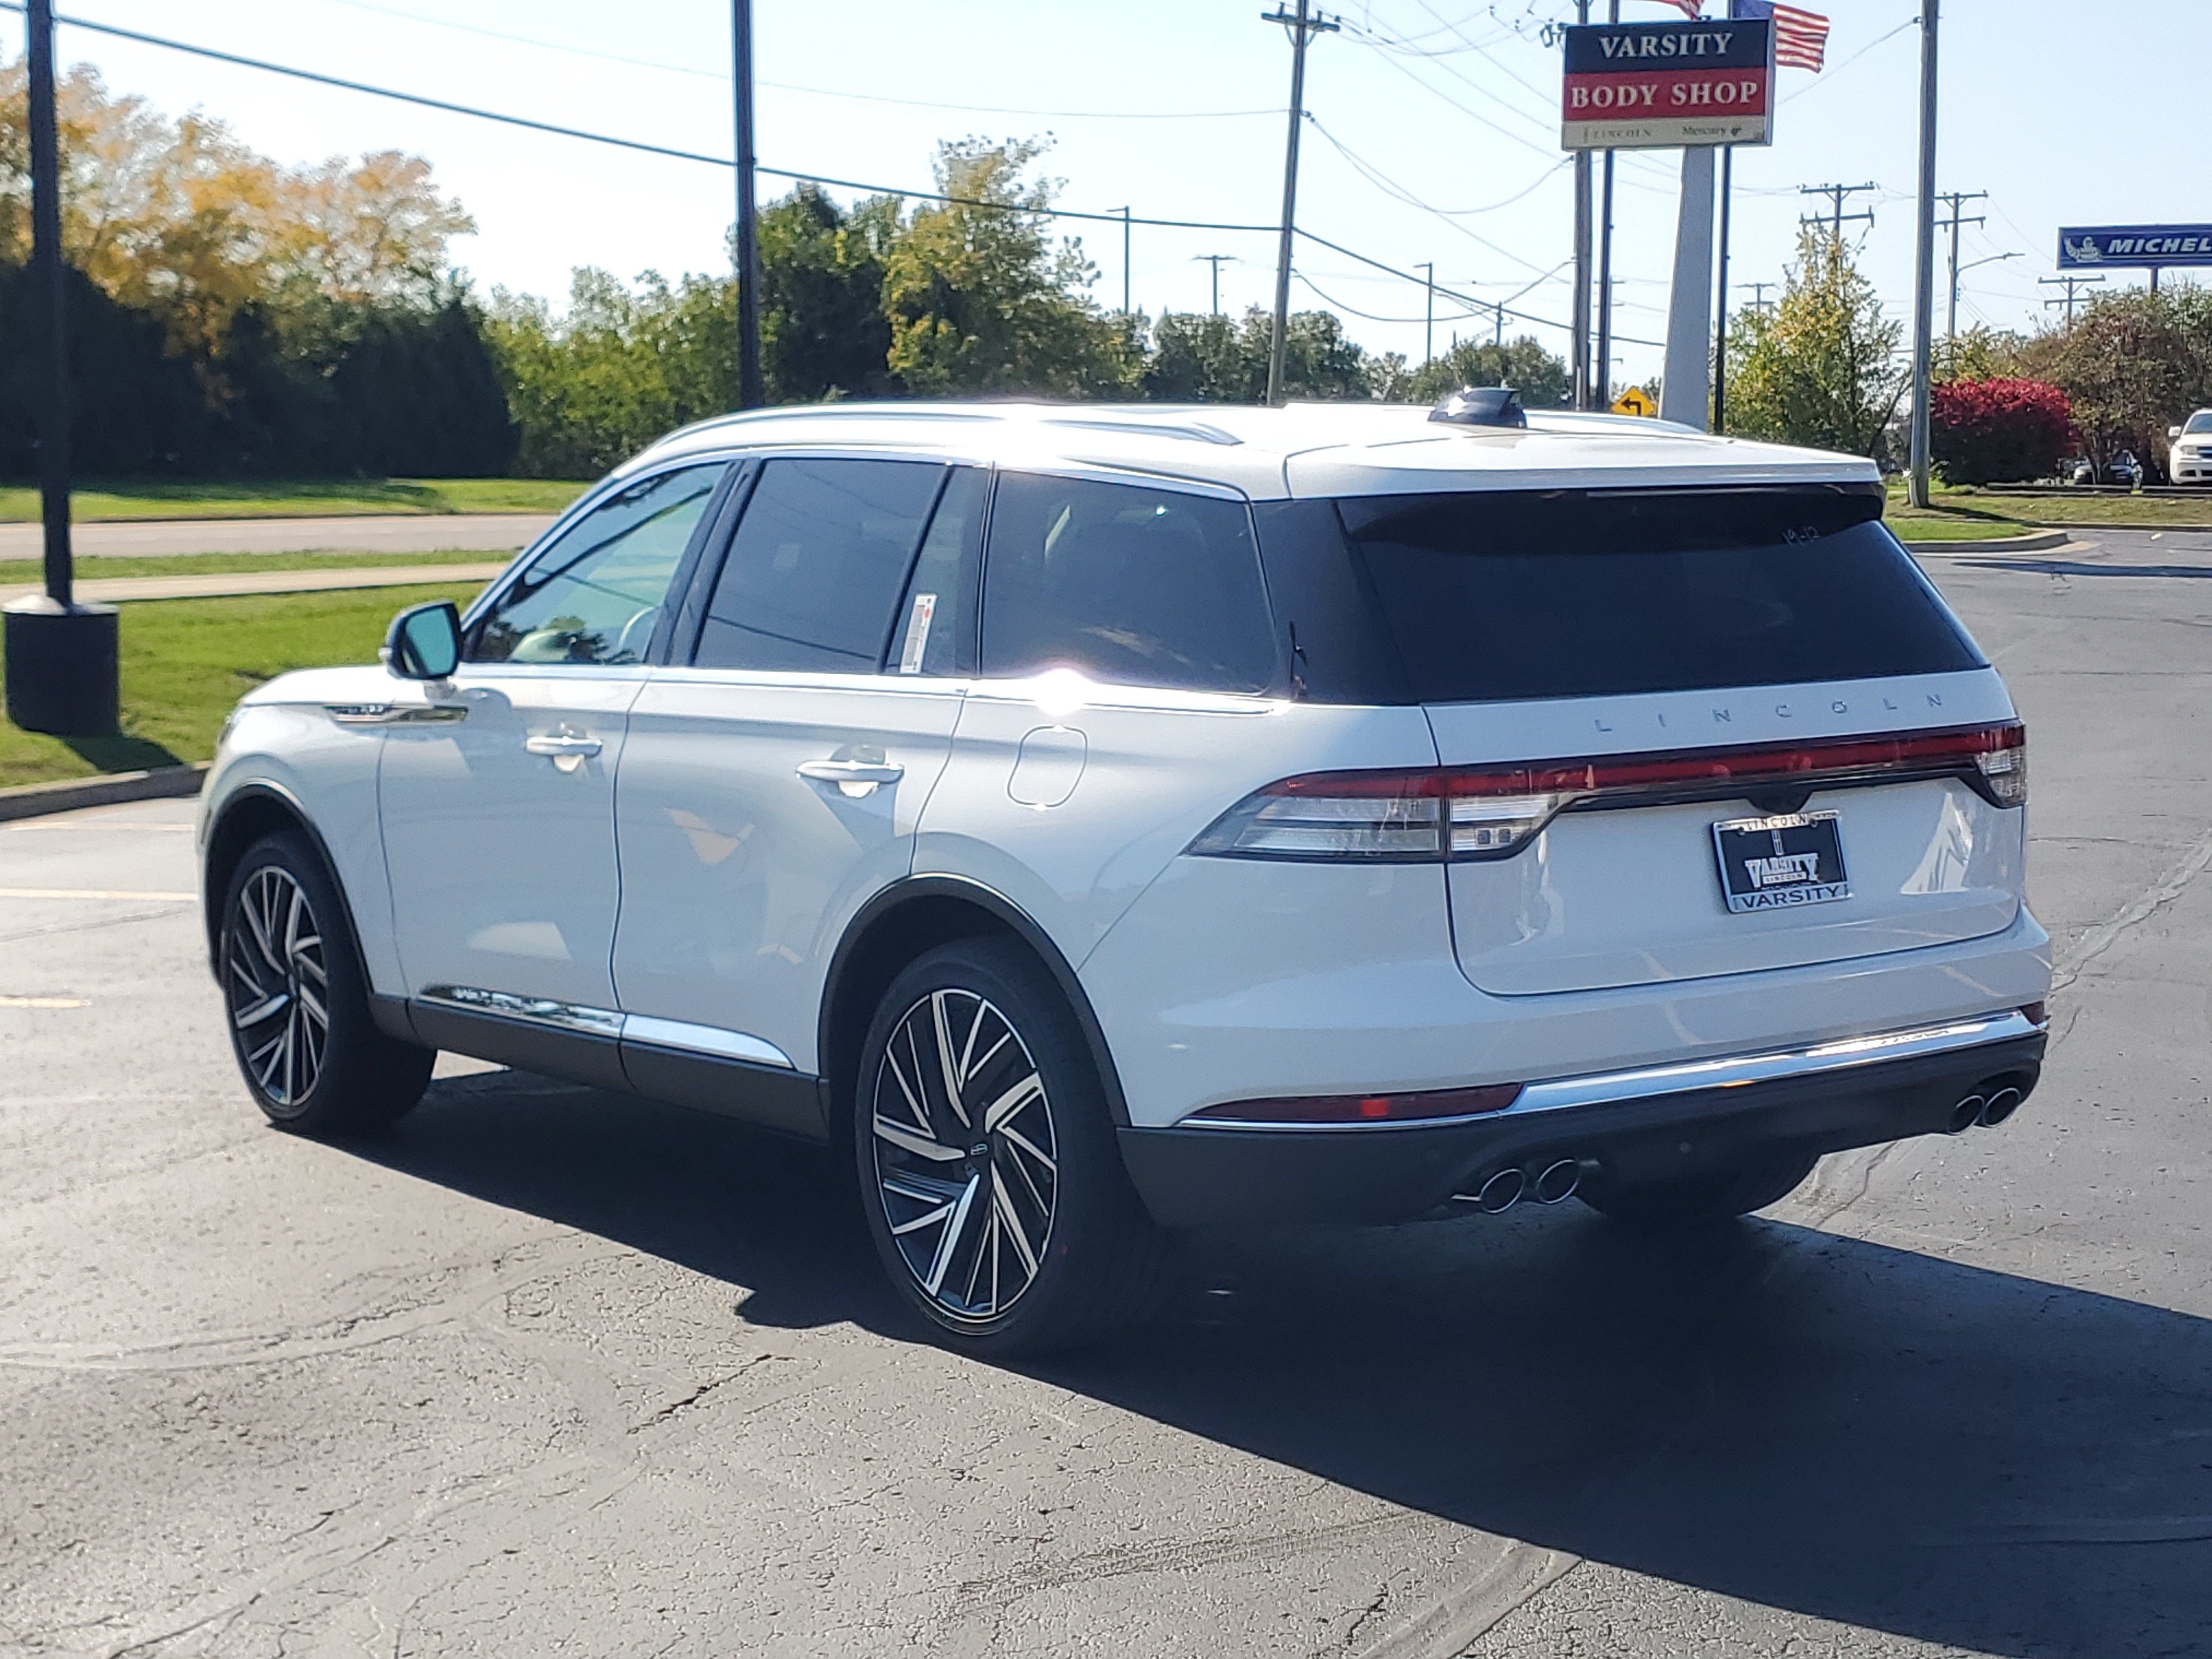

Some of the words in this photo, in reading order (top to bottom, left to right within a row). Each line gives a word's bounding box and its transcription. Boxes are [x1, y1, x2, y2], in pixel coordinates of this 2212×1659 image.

[1599, 32, 1733, 59] VARSITY
[1571, 84, 1658, 109] BODY
[1671, 81, 1758, 106] SHOP
[2107, 237, 2212, 253] MICHEL
[1594, 693, 1943, 732] LINCOLN
[1747, 814, 1807, 831] LINCOLN
[1745, 853, 1819, 888] VARSITY
[1741, 885, 1840, 908] VARSITY
